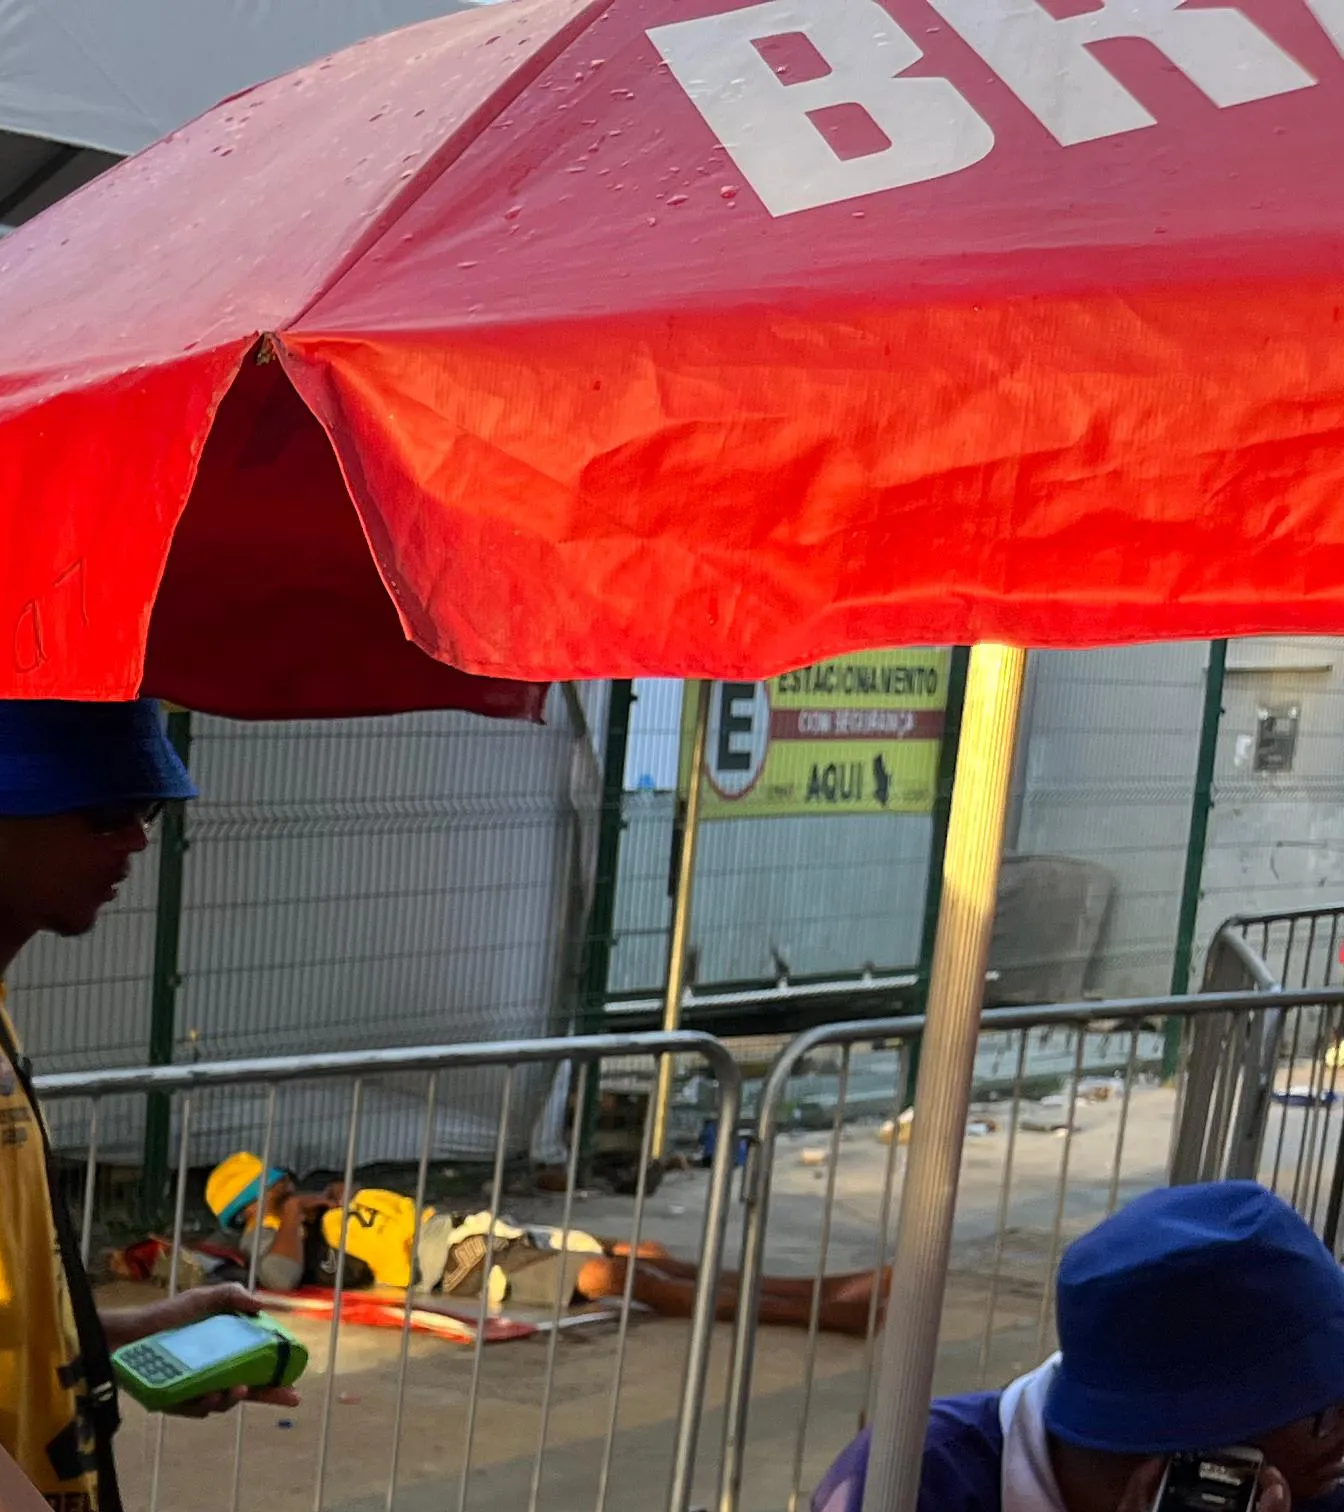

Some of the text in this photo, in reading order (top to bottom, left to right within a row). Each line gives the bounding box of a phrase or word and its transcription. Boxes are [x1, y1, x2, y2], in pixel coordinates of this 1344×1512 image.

[645, 0, 1344, 218] BR
[777, 664, 939, 697] ESTACIONAMENTO
[716, 682, 756, 771] E
[805, 761, 864, 804] AQUI
